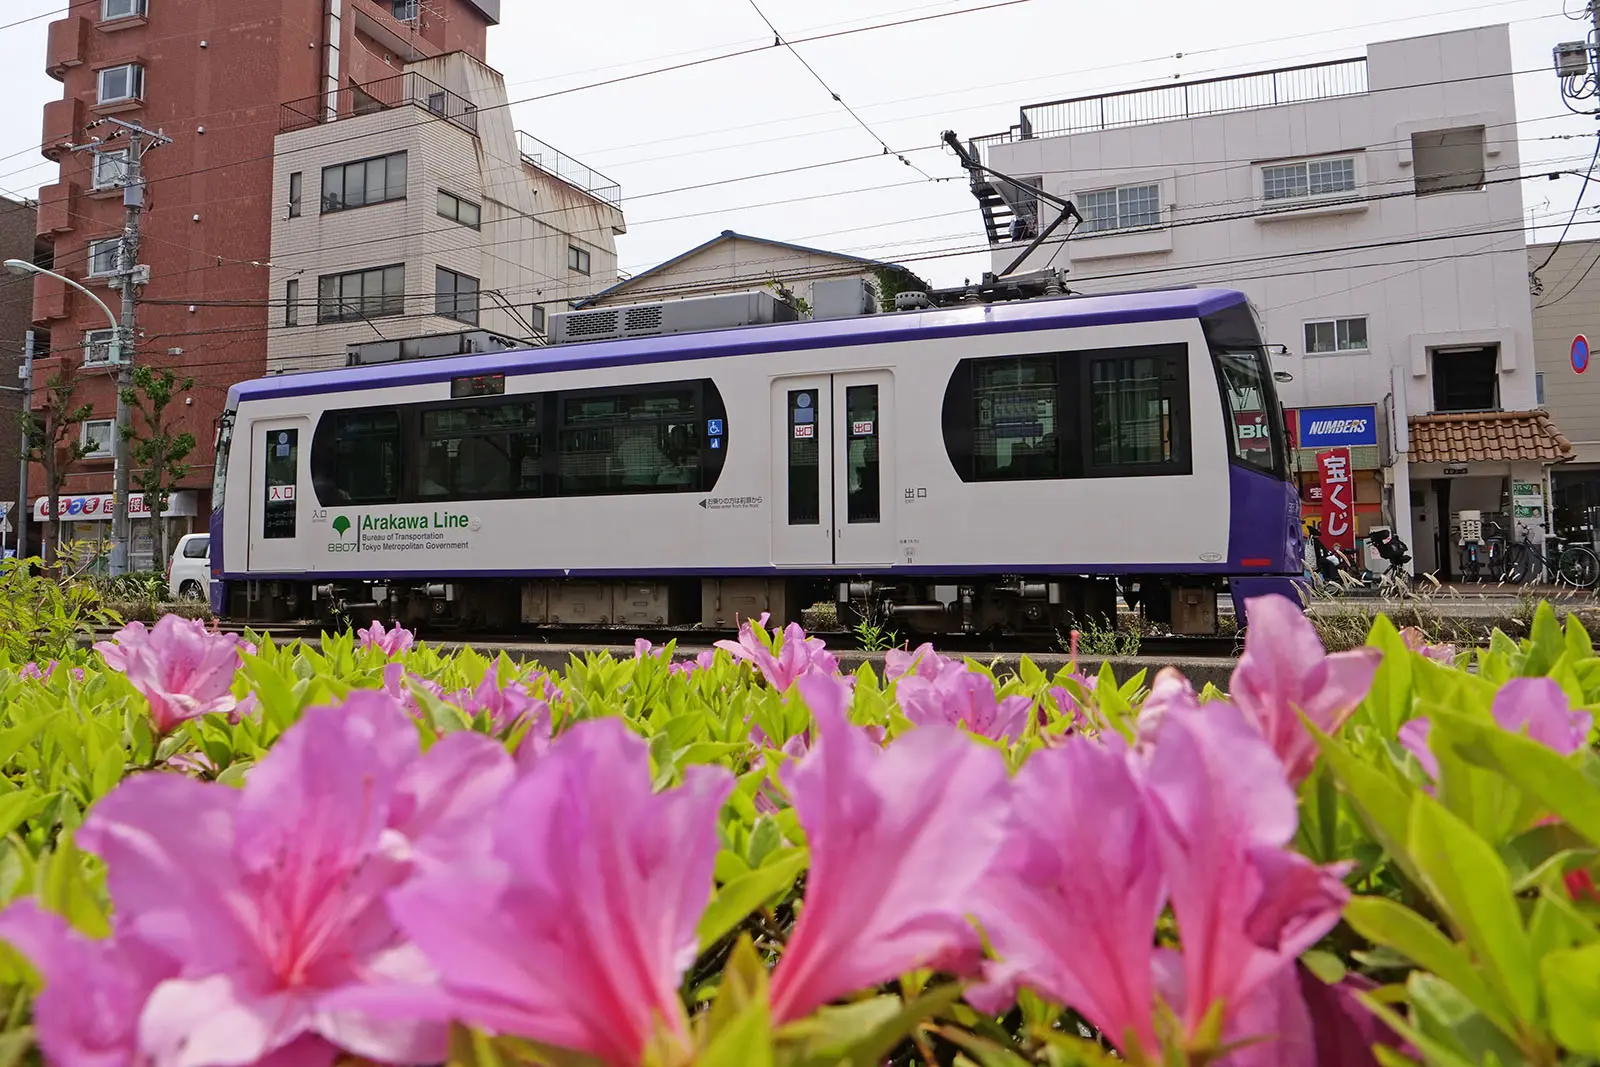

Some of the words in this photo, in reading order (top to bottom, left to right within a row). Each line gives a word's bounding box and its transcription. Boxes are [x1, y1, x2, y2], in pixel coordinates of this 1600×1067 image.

[796, 426, 812, 437] 出口
[855, 423, 872, 433] 出口
[1309, 419, 1367, 435] NUMBERS
[271, 487, 293, 499] 入口
[905, 487, 927, 499] 出口
[1324, 456, 1348, 536] 宝くじ
[312, 510, 327, 518] 入口
[362, 514, 428, 530] Arakawa
[434, 512, 469, 528] Line
[362, 533, 385, 541] Bureau
[395, 532, 444, 541] Transportation
[328, 543, 357, 552] 8807
[362, 543, 381, 552] Tokyo
[383, 541, 424, 551] Metropolitan
[426, 541, 469, 550] Government
